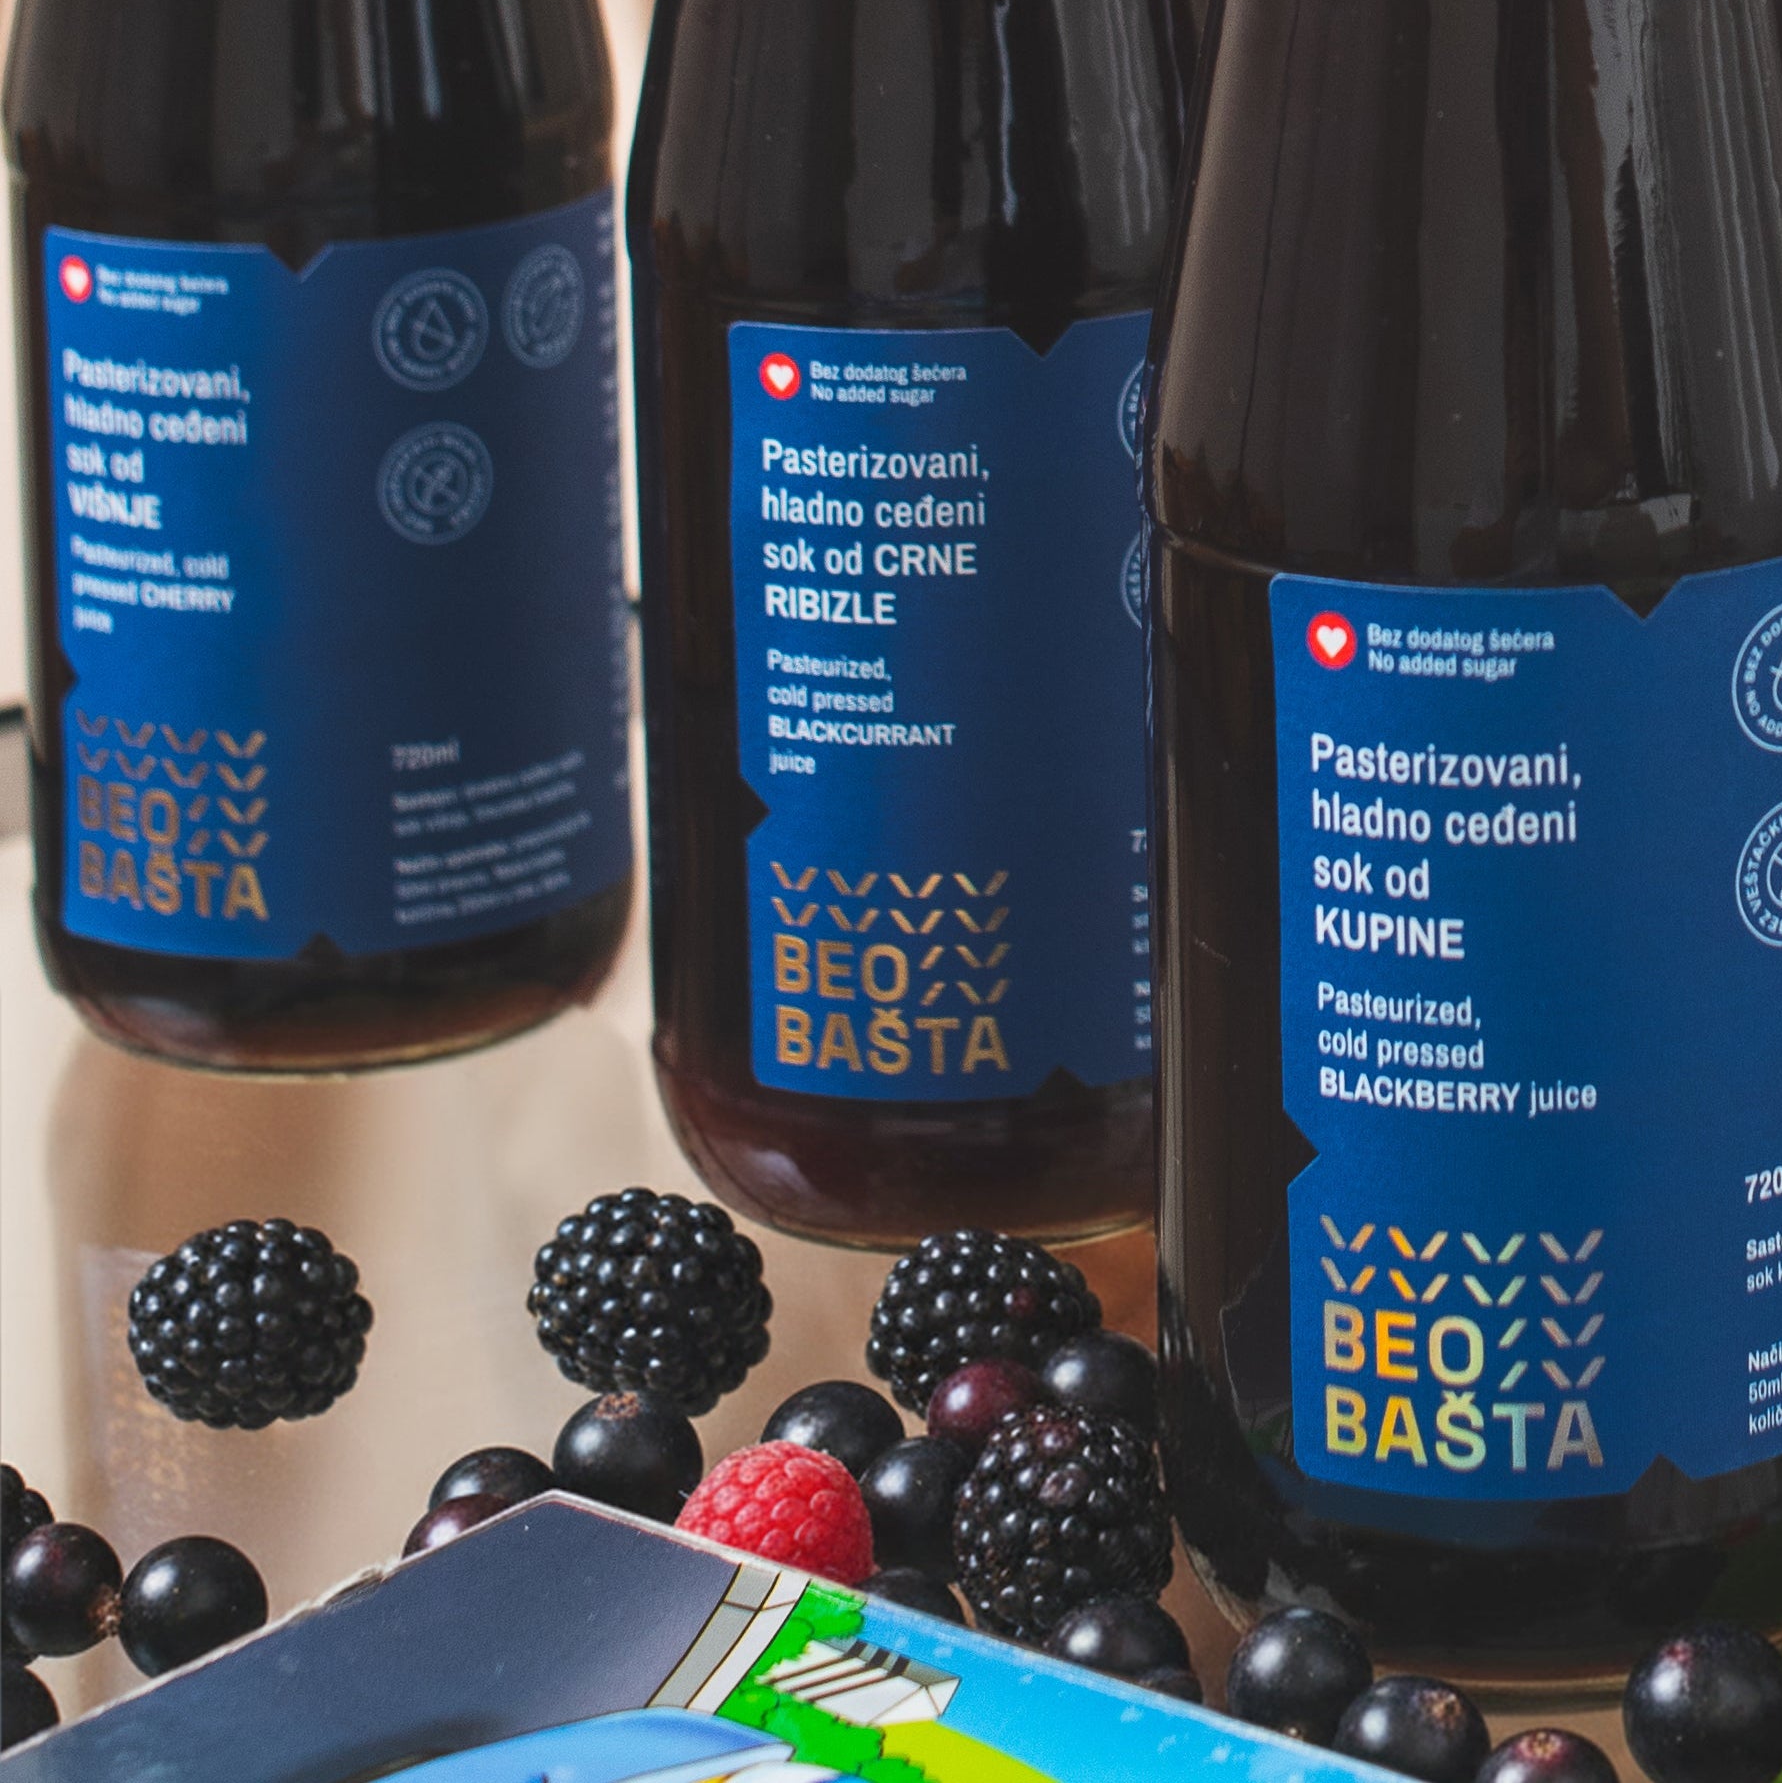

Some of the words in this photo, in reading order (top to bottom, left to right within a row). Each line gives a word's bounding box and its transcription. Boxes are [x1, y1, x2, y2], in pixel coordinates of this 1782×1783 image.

[810, 360, 840, 380] Bez
[843, 363, 909, 385] dodatog
[810, 383, 834, 401] No
[836, 385, 886, 403] added
[889, 388, 936, 407] sugar
[110, 448, 145, 483] od
[761, 438, 990, 481] Pasterizovani,
[761, 485, 864, 528] hladno
[874, 492, 986, 529] ceđeni
[763, 538, 816, 573] sok
[824, 541, 863, 575] od
[873, 543, 978, 578] CRNE
[764, 584, 897, 626] RIBIZLE
[1367, 623, 1403, 647] Bez
[1406, 625, 1484, 655] dodatog
[1489, 628, 1555, 652] šećera
[766, 648, 893, 681] Pasteurized,
[1368, 649, 1395, 673] No
[1398, 652, 1457, 676] added
[1462, 657, 1517, 682] sugar
[1743, 646, 1763, 684] BEZ
[767, 684, 807, 708] cold
[812, 689, 894, 715] pressed
[1745, 689, 1761, 717] NO
[768, 715, 957, 746] BLACKCURRANT
[769, 748, 816, 775] juice
[1311, 732, 1582, 789] Pasterizovani,
[77, 774, 180, 847] BEO
[1312, 787, 1431, 842] hladno
[1445, 799, 1577, 844] ceđeni
[78, 840, 270, 921] BAŠTA
[1313, 851, 1374, 894] sok
[1384, 857, 1430, 900] od
[1315, 904, 1465, 959] KUPINE
[773, 933, 909, 1004] BEO
[1317, 981, 1481, 1030] Pasteurized,
[776, 1003, 1010, 1076] BAŠTA
[1318, 1027, 1368, 1060] cold
[1377, 1038, 1484, 1069] pressed
[1319, 1066, 1521, 1112] BLACKBERRY
[1528, 1079, 1597, 1118] juice
[1746, 1265, 1774, 1293] sok
[1323, 1298, 1485, 1386] BEO
[1326, 1383, 1604, 1472] BAŠTA
